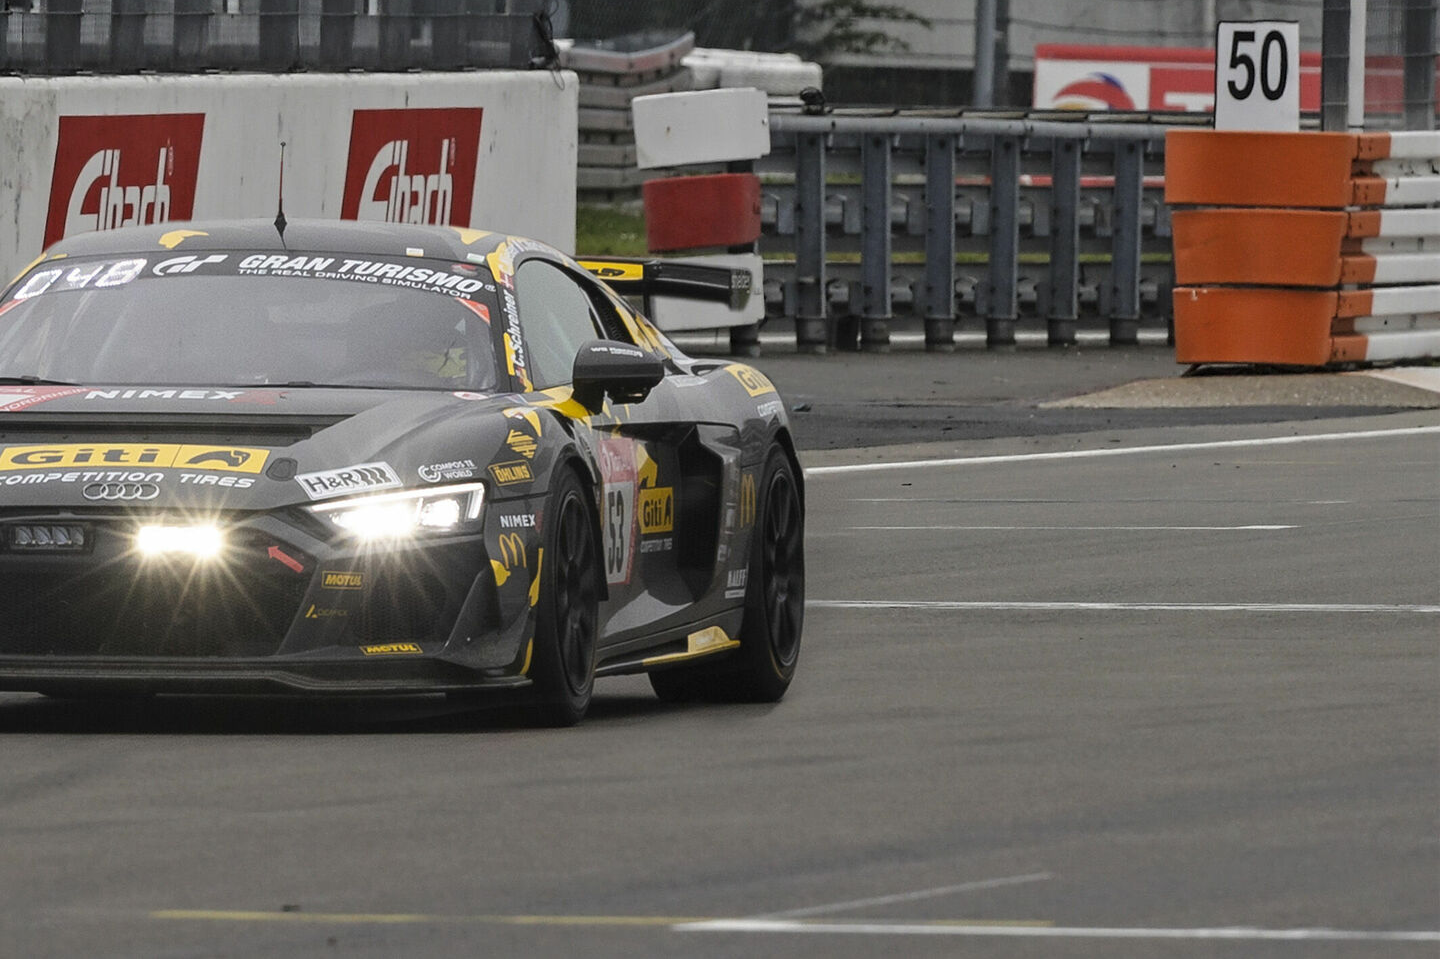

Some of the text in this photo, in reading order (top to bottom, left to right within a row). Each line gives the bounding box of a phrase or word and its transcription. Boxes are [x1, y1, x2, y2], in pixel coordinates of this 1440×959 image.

[1227, 30, 1288, 101] 50
[14, 258, 148, 300] 048
[238, 254, 484, 293] GRAN TURISMO
[237, 268, 472, 300] THE REAL DRIVING SIMULATOR
[84, 389, 246, 400] NIMEX
[11, 448, 161, 465] Giti
[179, 473, 256, 489] TIRES
[443, 469, 473, 480] WORLD
[493, 466, 531, 483] ÖHLINS
[499, 514, 536, 529] NIMEX
[643, 498, 662, 528] Giti
[607, 489, 625, 575] 53
[324, 574, 362, 586] MOTUL
[366, 644, 418, 653] MOTUL
